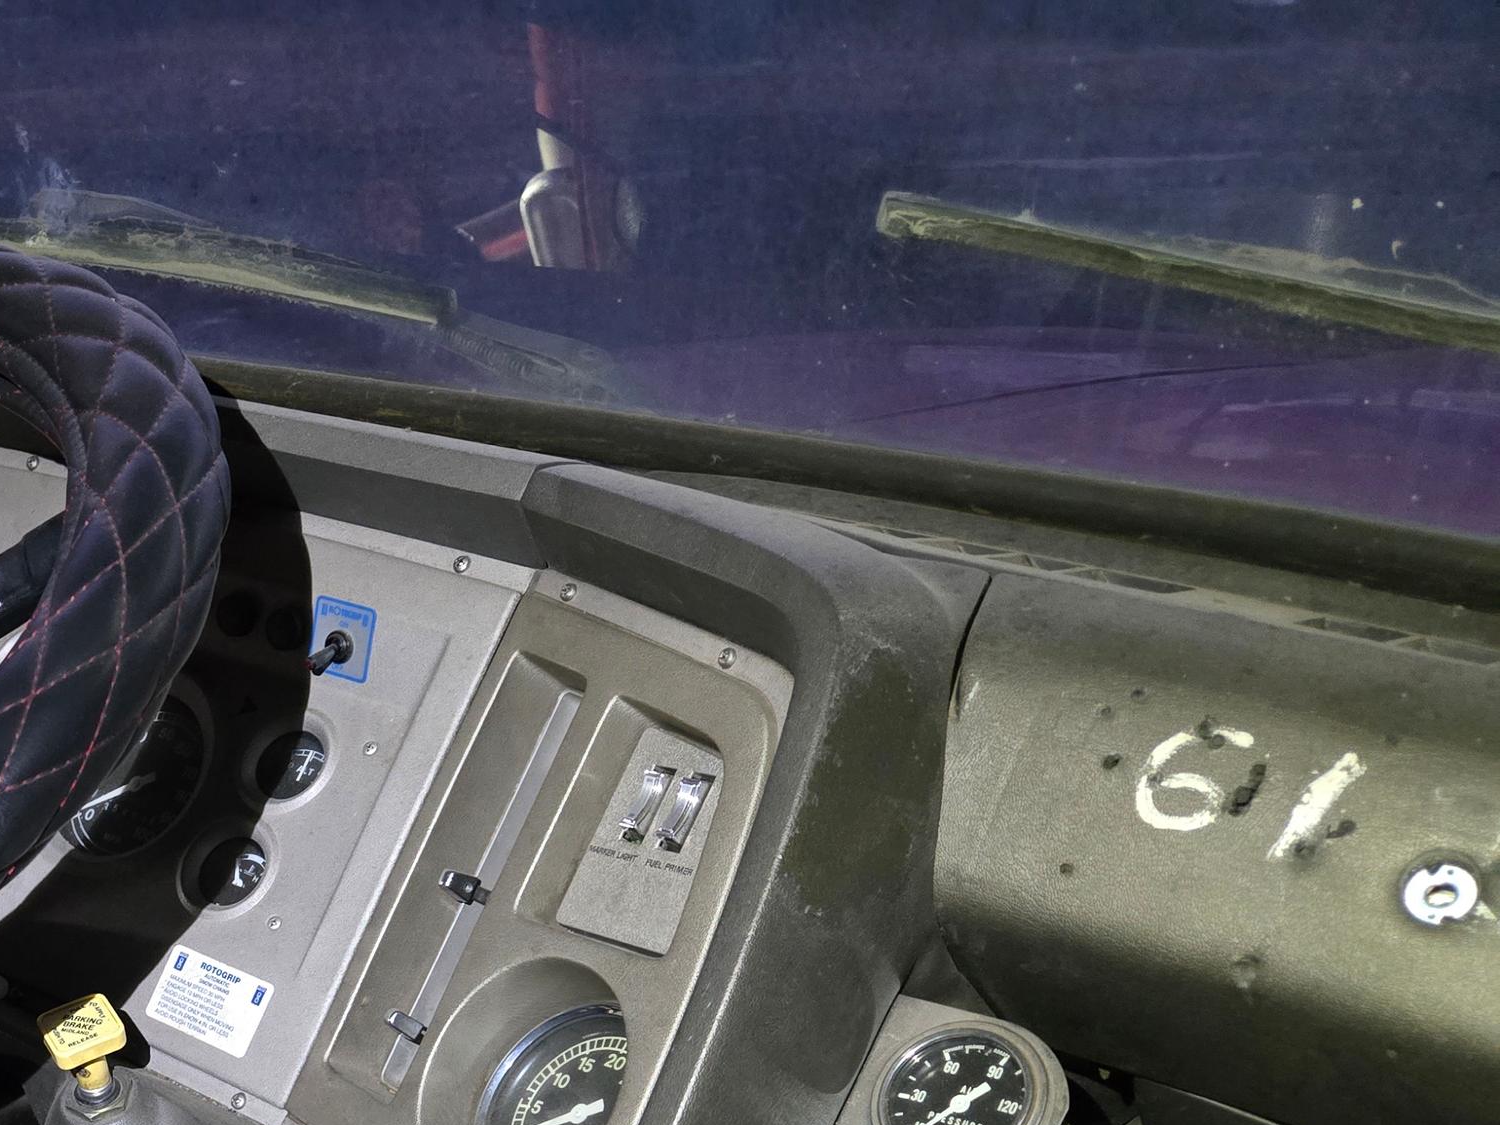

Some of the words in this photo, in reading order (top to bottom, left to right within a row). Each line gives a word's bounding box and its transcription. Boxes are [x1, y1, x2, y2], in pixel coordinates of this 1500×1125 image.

[589, 844, 616, 857] MARKER
[616, 852, 638, 862] LIGHT
[645, 859, 662, 869] FUEL
[664, 863, 694, 876] PRIMER
[200, 961, 241, 984] ROTOGRIP
[204, 974, 230, 988] AUTOMATIC
[62, 1020, 96, 1031] BRAKE
[64, 1014, 103, 1025] PARKING
[61, 1028, 90, 1036] MIDLAND
[67, 1032, 99, 1048] RELEASE
[578, 1056, 596, 1073] 15
[603, 1053, 626, 1071] 20
[943, 1061, 960, 1075] 60
[986, 1065, 1004, 1080] 90
[552, 1072, 571, 1089] 10
[910, 1088, 927, 1103] 30
[531, 1099, 544, 1114] 5
[997, 1098, 1018, 1115] 120
